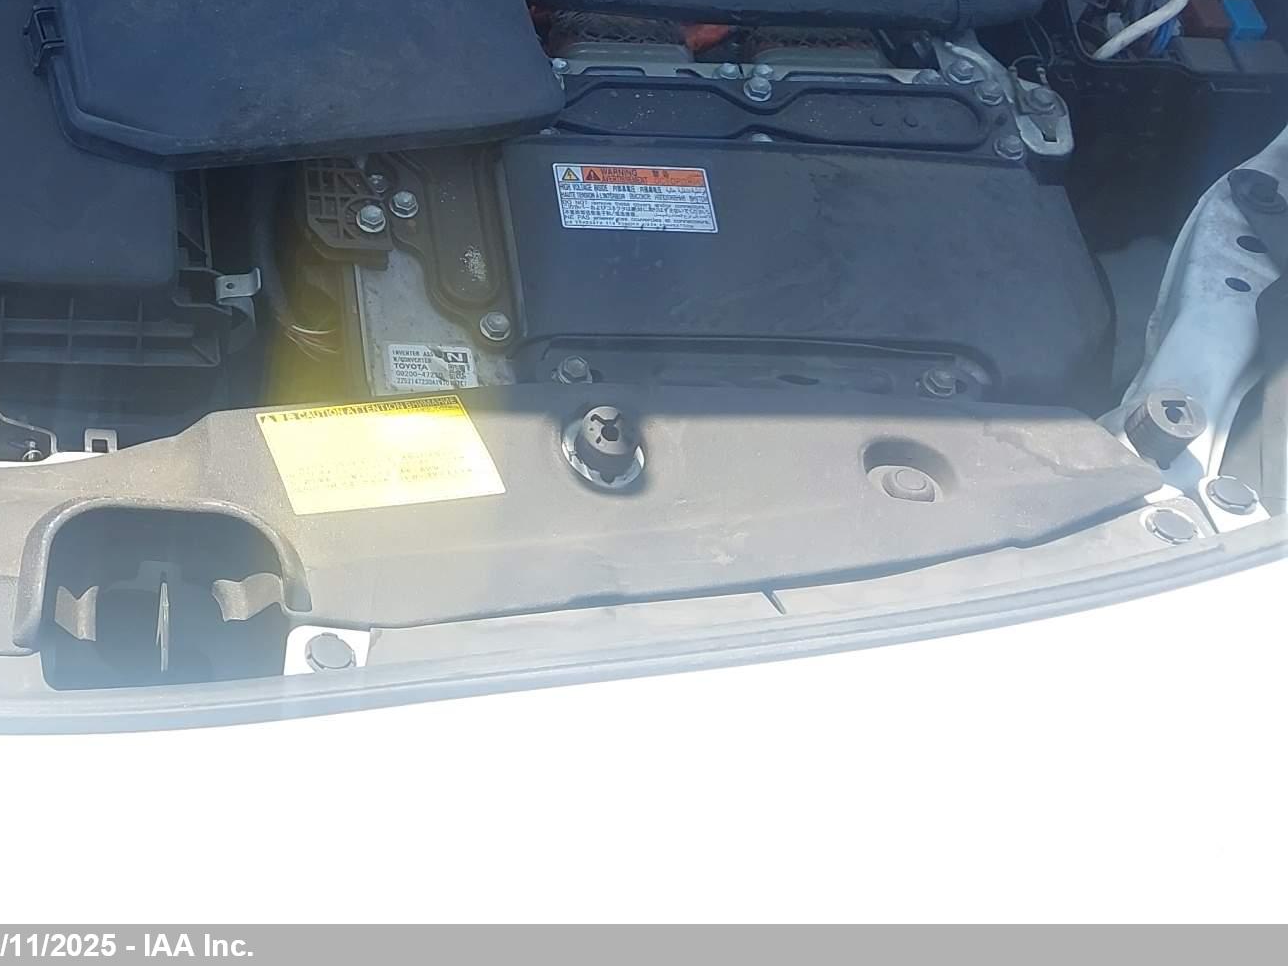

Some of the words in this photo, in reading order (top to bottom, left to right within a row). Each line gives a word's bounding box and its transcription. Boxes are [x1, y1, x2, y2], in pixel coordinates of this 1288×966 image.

[600, 168, 638, 177] WARNING
[394, 363, 429, 371] TOYOTA
[295, 408, 344, 419] CAUTION
[345, 401, 402, 416] ATTENTION
